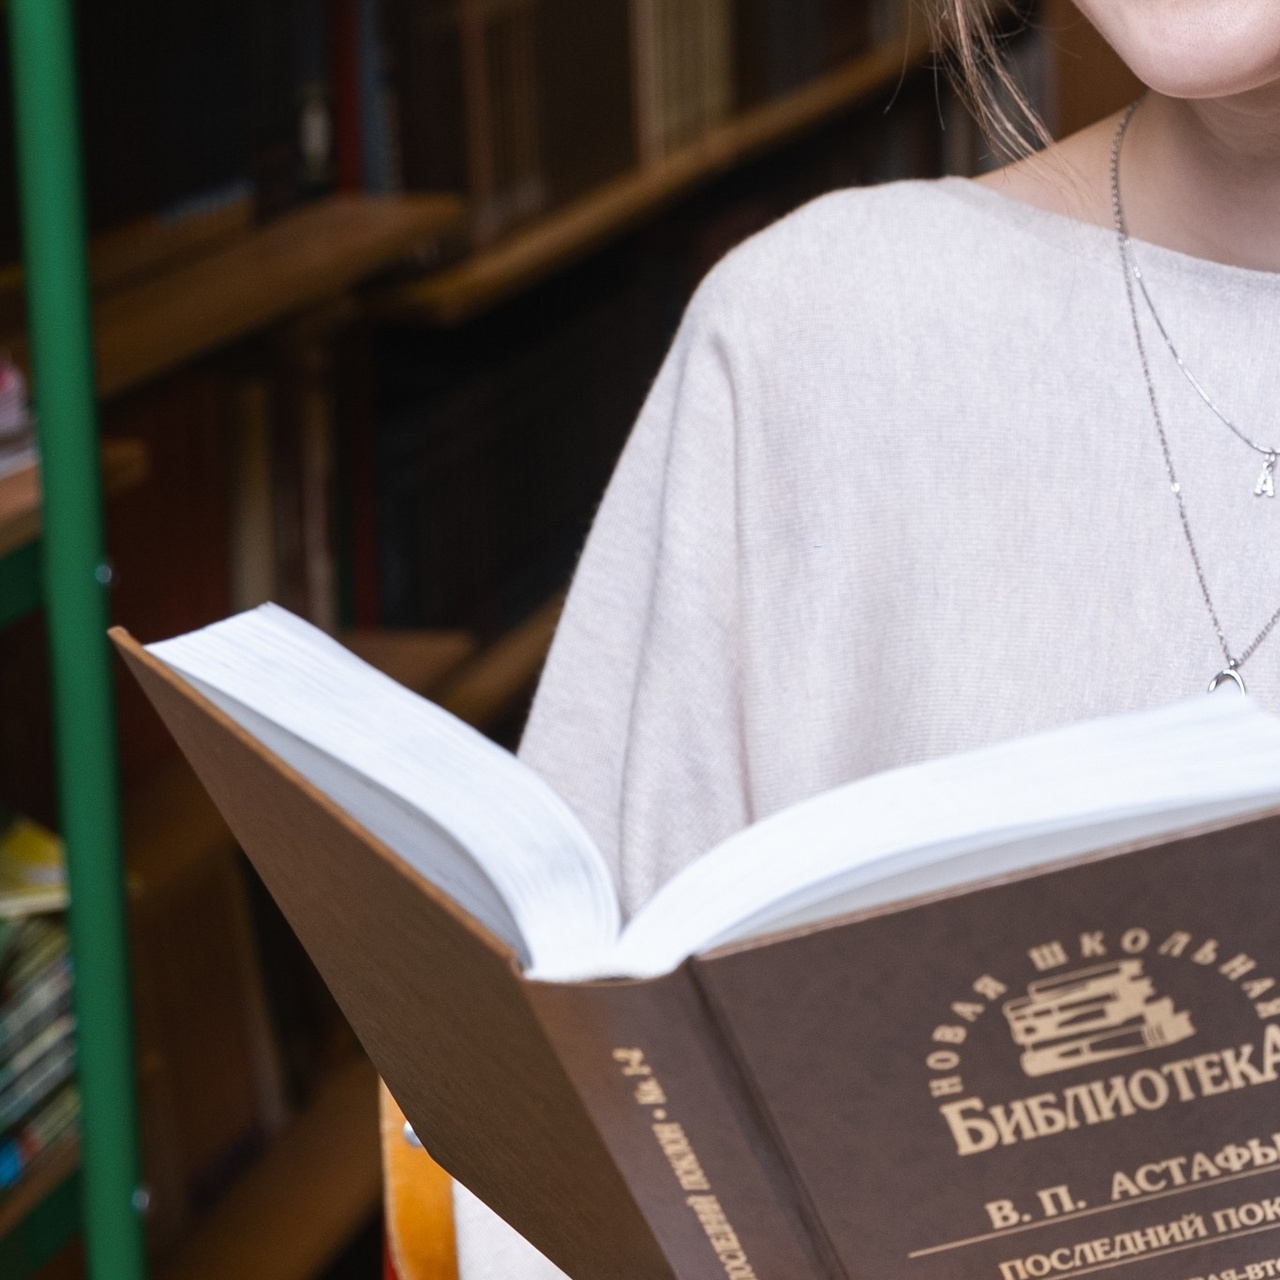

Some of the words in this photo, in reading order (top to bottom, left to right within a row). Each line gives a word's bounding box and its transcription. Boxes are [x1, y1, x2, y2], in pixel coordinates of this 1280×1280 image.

[926, 974, 1008, 1098] НОВАЯ
[985, 1199, 1031, 1229] В.
[1037, 1185, 1087, 1216] П.
